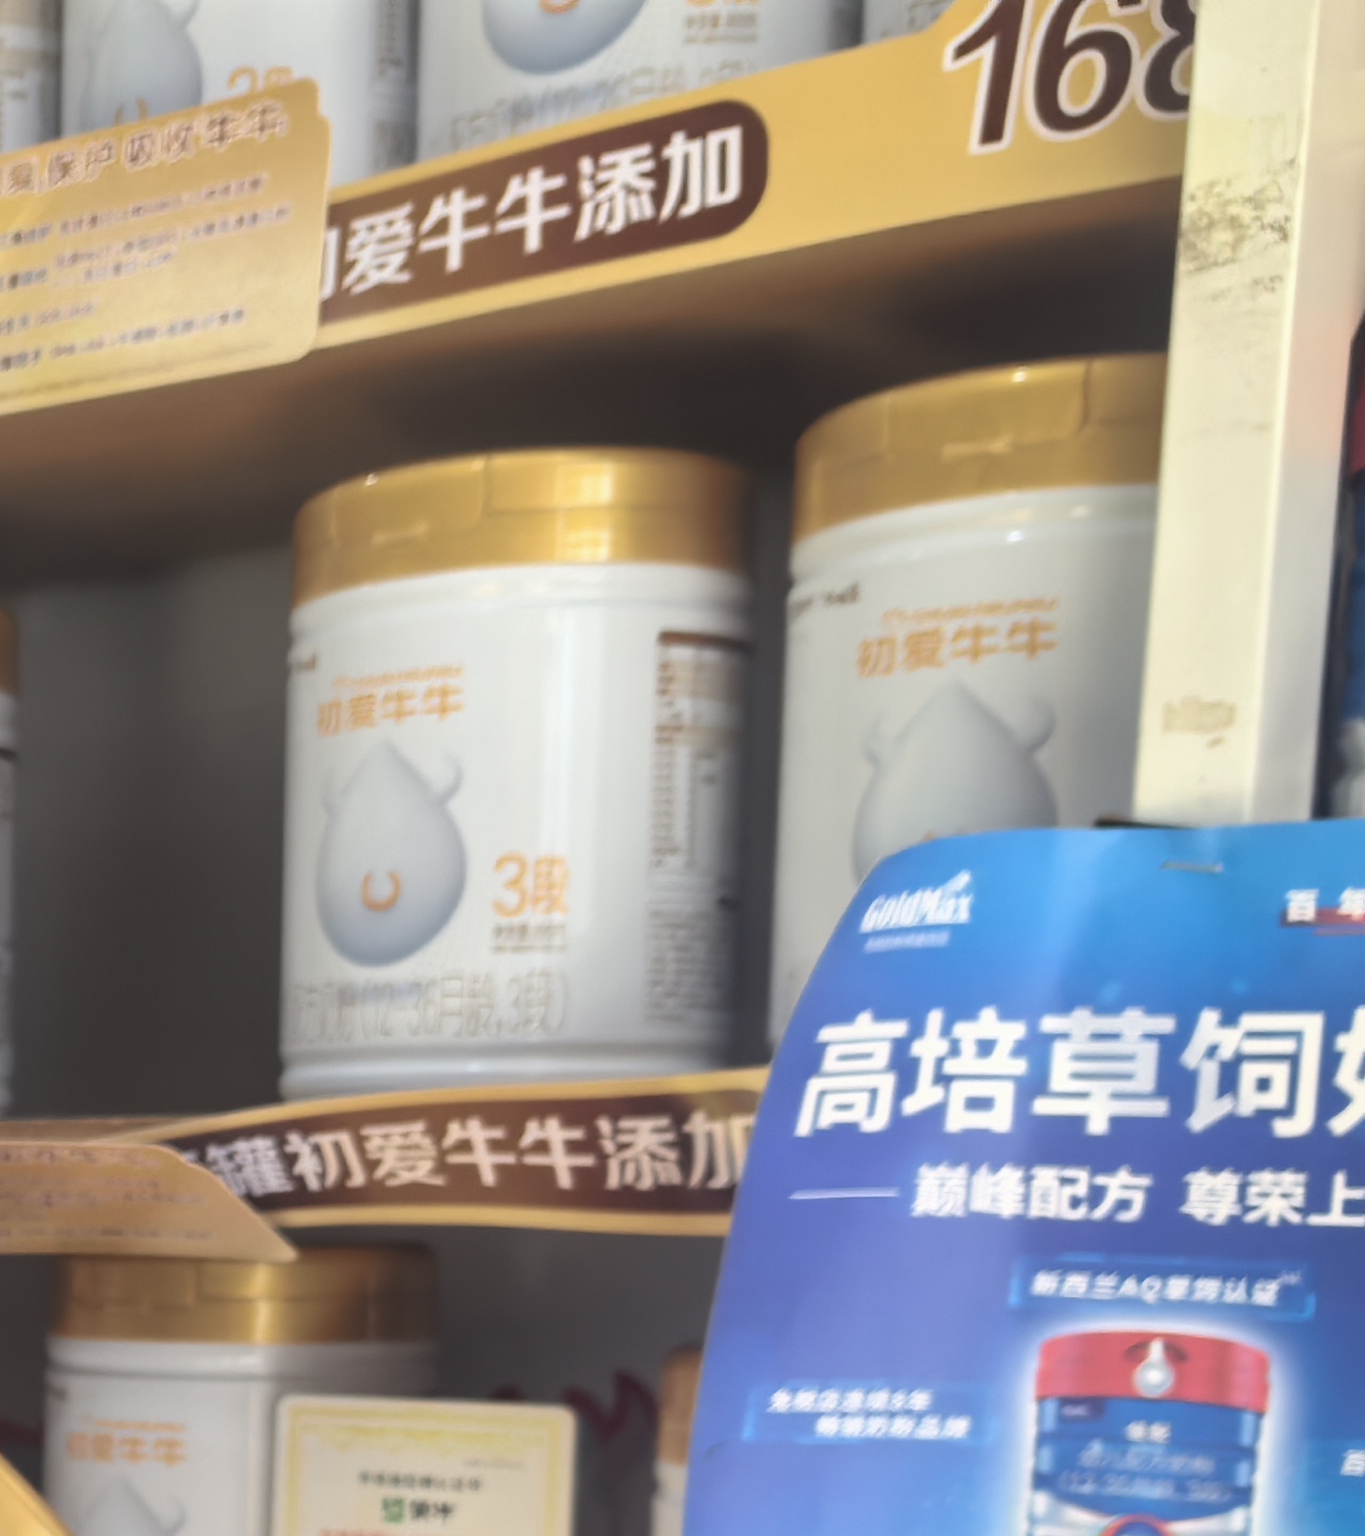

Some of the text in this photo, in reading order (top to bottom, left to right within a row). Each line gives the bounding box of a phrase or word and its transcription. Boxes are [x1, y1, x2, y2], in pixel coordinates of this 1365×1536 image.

[856, 616, 1059, 678] 初爱牛牛
[316, 679, 465, 737] 初爱牛牛
[491, 850, 572, 919] 3段
[910, 1164, 1153, 1223] 巅峰配方
